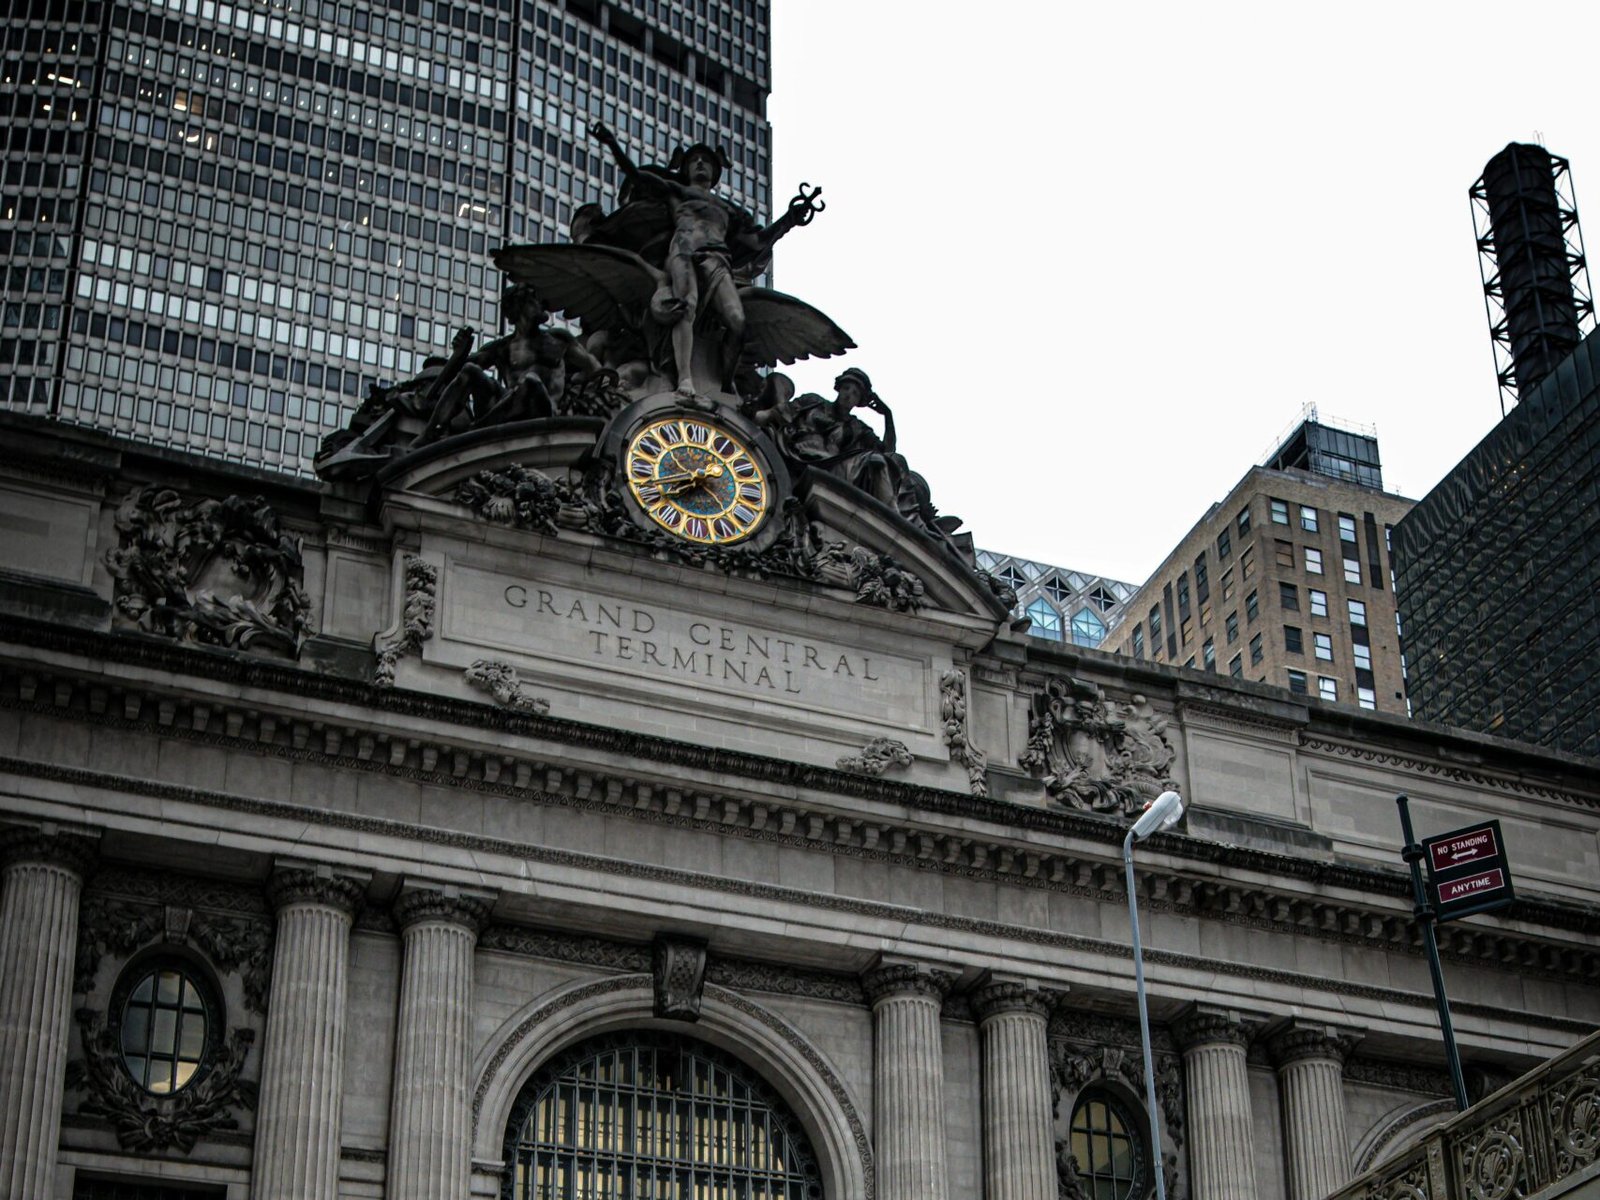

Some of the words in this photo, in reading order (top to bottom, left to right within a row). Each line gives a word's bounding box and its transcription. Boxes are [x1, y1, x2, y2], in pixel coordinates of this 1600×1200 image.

[503, 584, 656, 635] GRAND
[688, 622, 880, 682] CENTRAL
[589, 630, 802, 694] TERMINAL
[1437, 846, 1449, 856] NO
[1451, 834, 1488, 851] STANDING
[1451, 877, 1491, 895] ANYTIME
